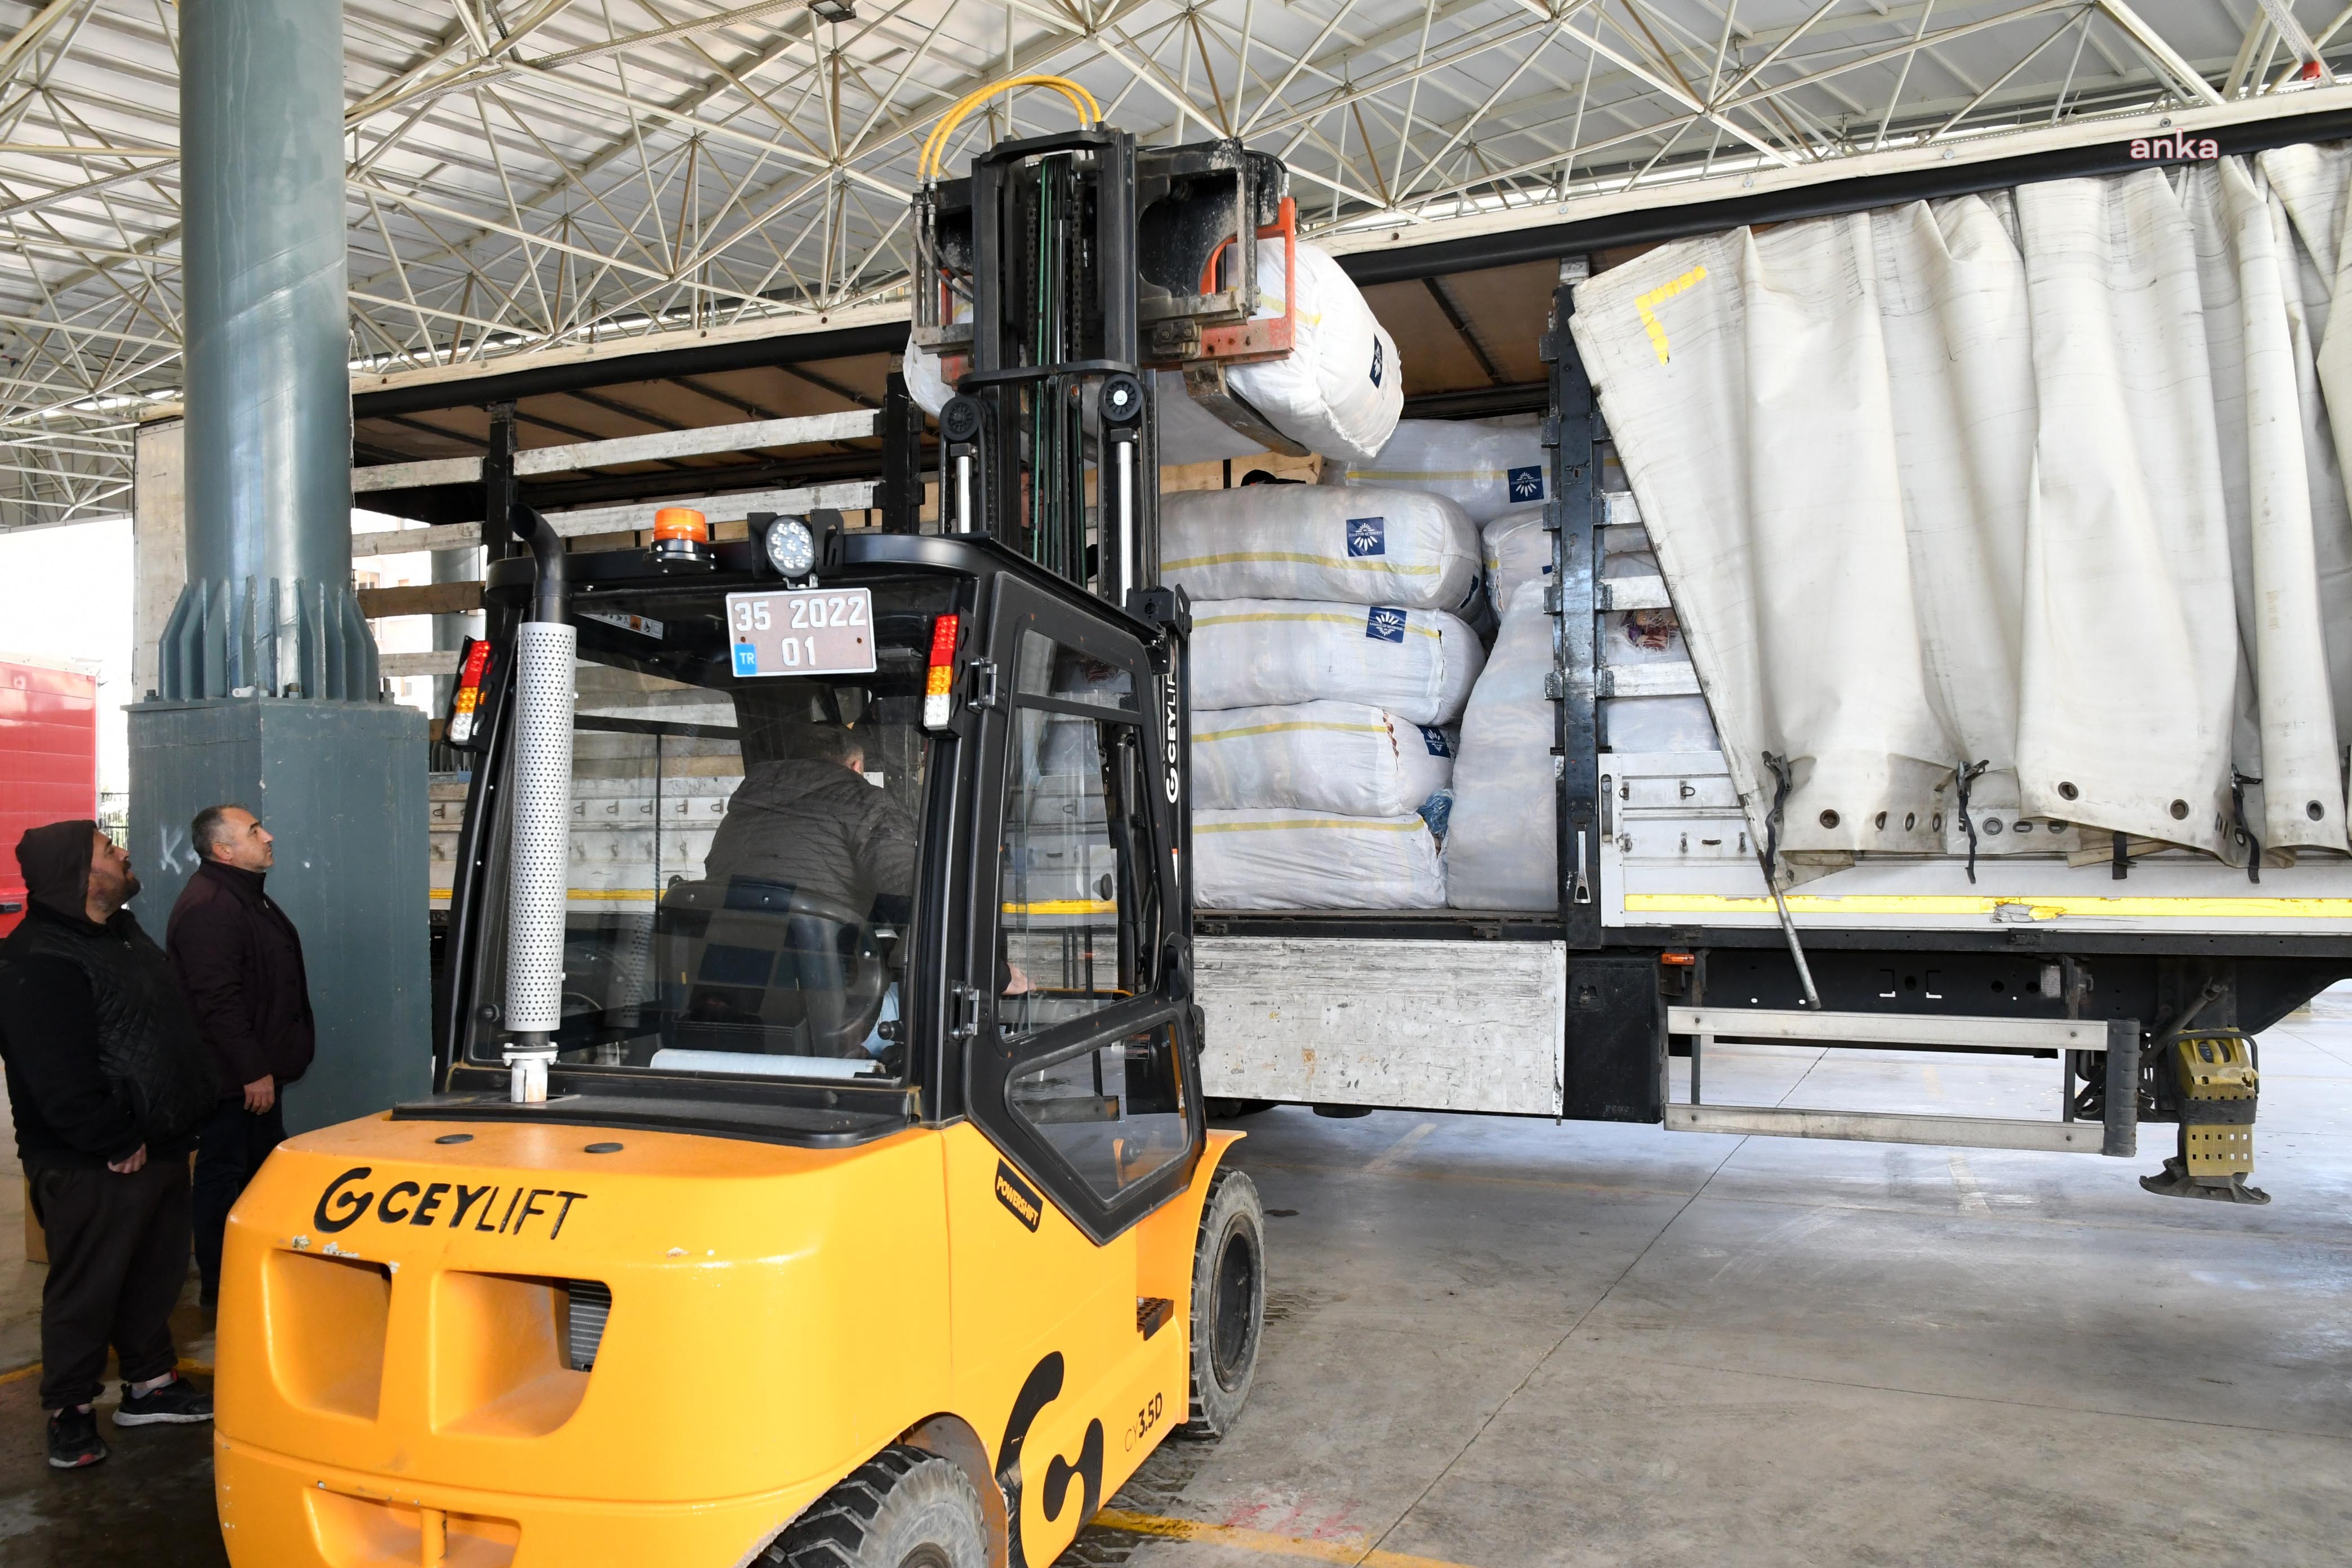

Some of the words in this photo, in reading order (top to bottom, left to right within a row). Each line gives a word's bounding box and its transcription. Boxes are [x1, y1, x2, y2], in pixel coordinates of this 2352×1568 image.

[734, 600, 772, 631] 35
[789, 596, 866, 629] 2022
[740, 652, 755, 665] TR
[781, 636, 817, 666] 01
[996, 1175, 1039, 1226] POWERSHIFT
